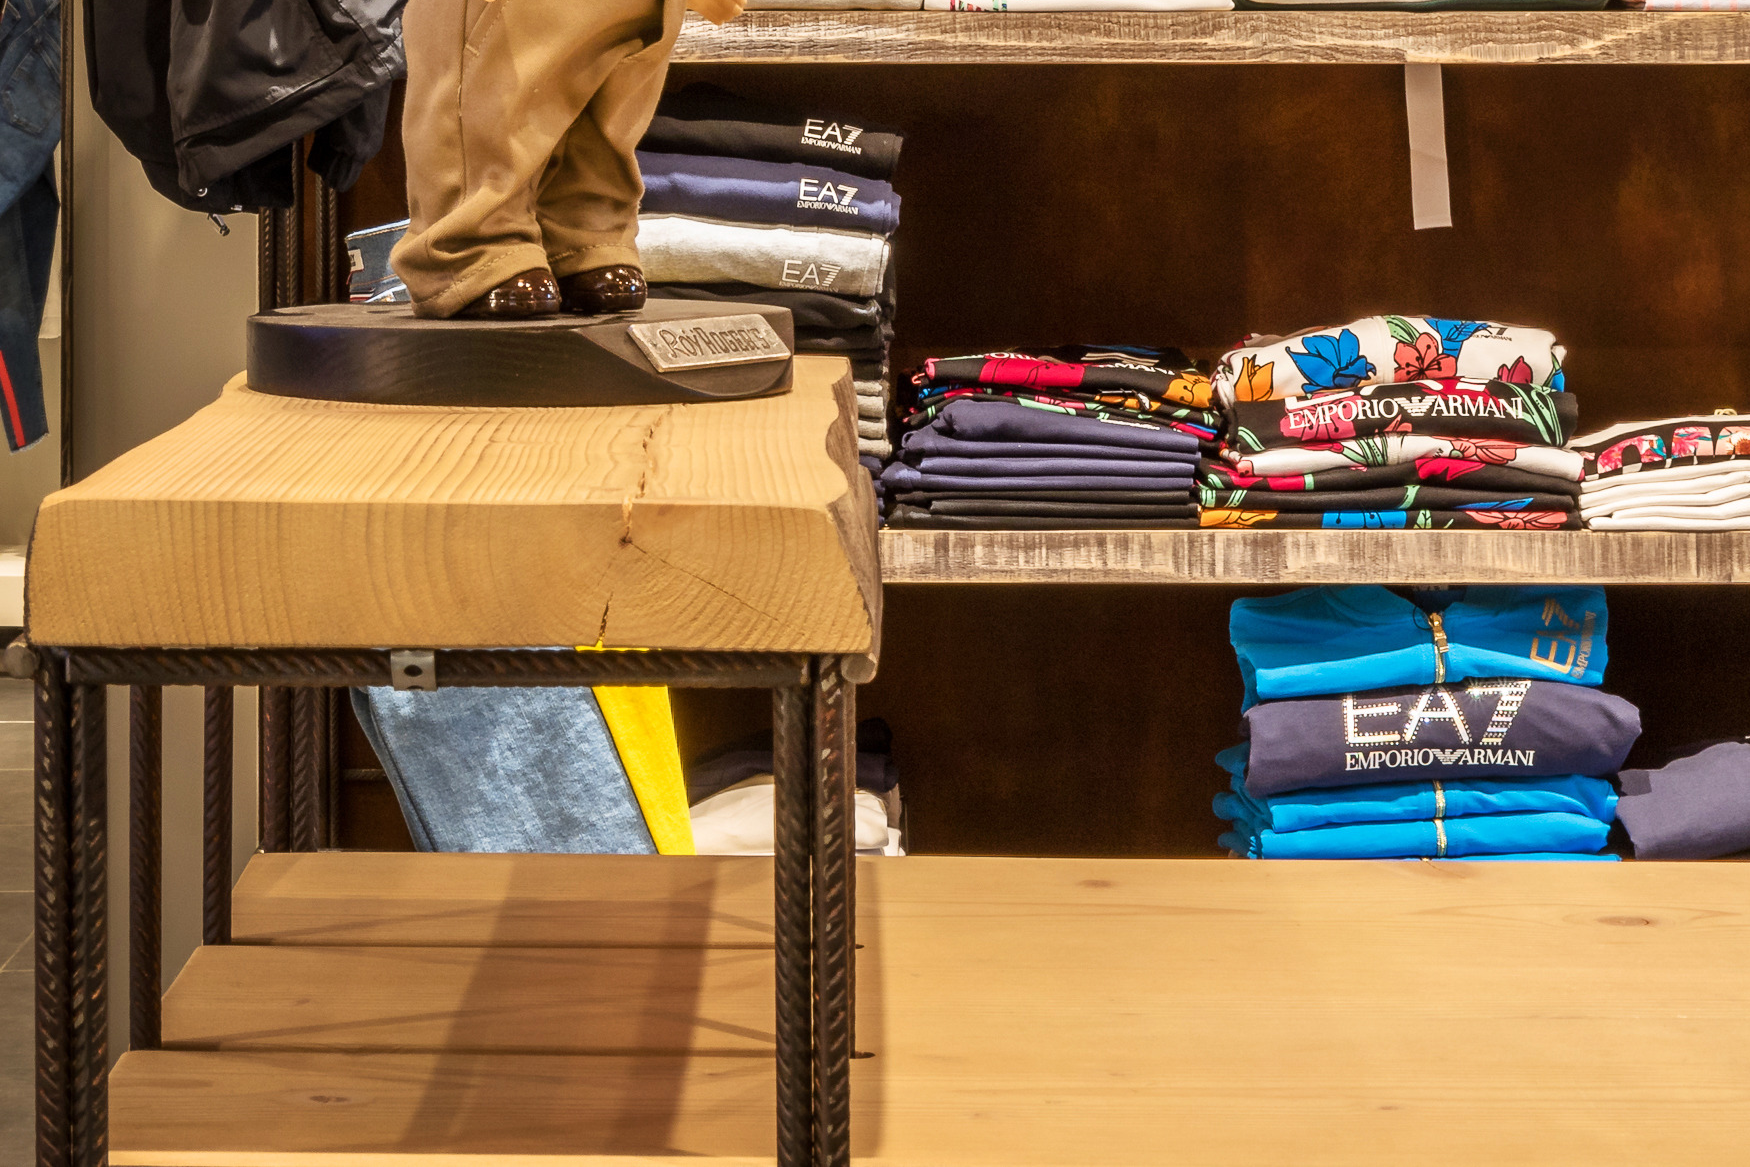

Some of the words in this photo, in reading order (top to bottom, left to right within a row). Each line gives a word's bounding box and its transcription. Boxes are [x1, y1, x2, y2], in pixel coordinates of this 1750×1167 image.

[804, 119, 863, 145] EA7
[800, 178, 859, 206] EA7
[782, 259, 841, 287] EA7
[1289, 397, 1399, 430] EMPORIO
[1431, 394, 1525, 420] ARMANI
[1343, 680, 1533, 747] EA7
[1345, 748, 1434, 771] EMPORIO
[1459, 748, 1535, 767] ARMANI
